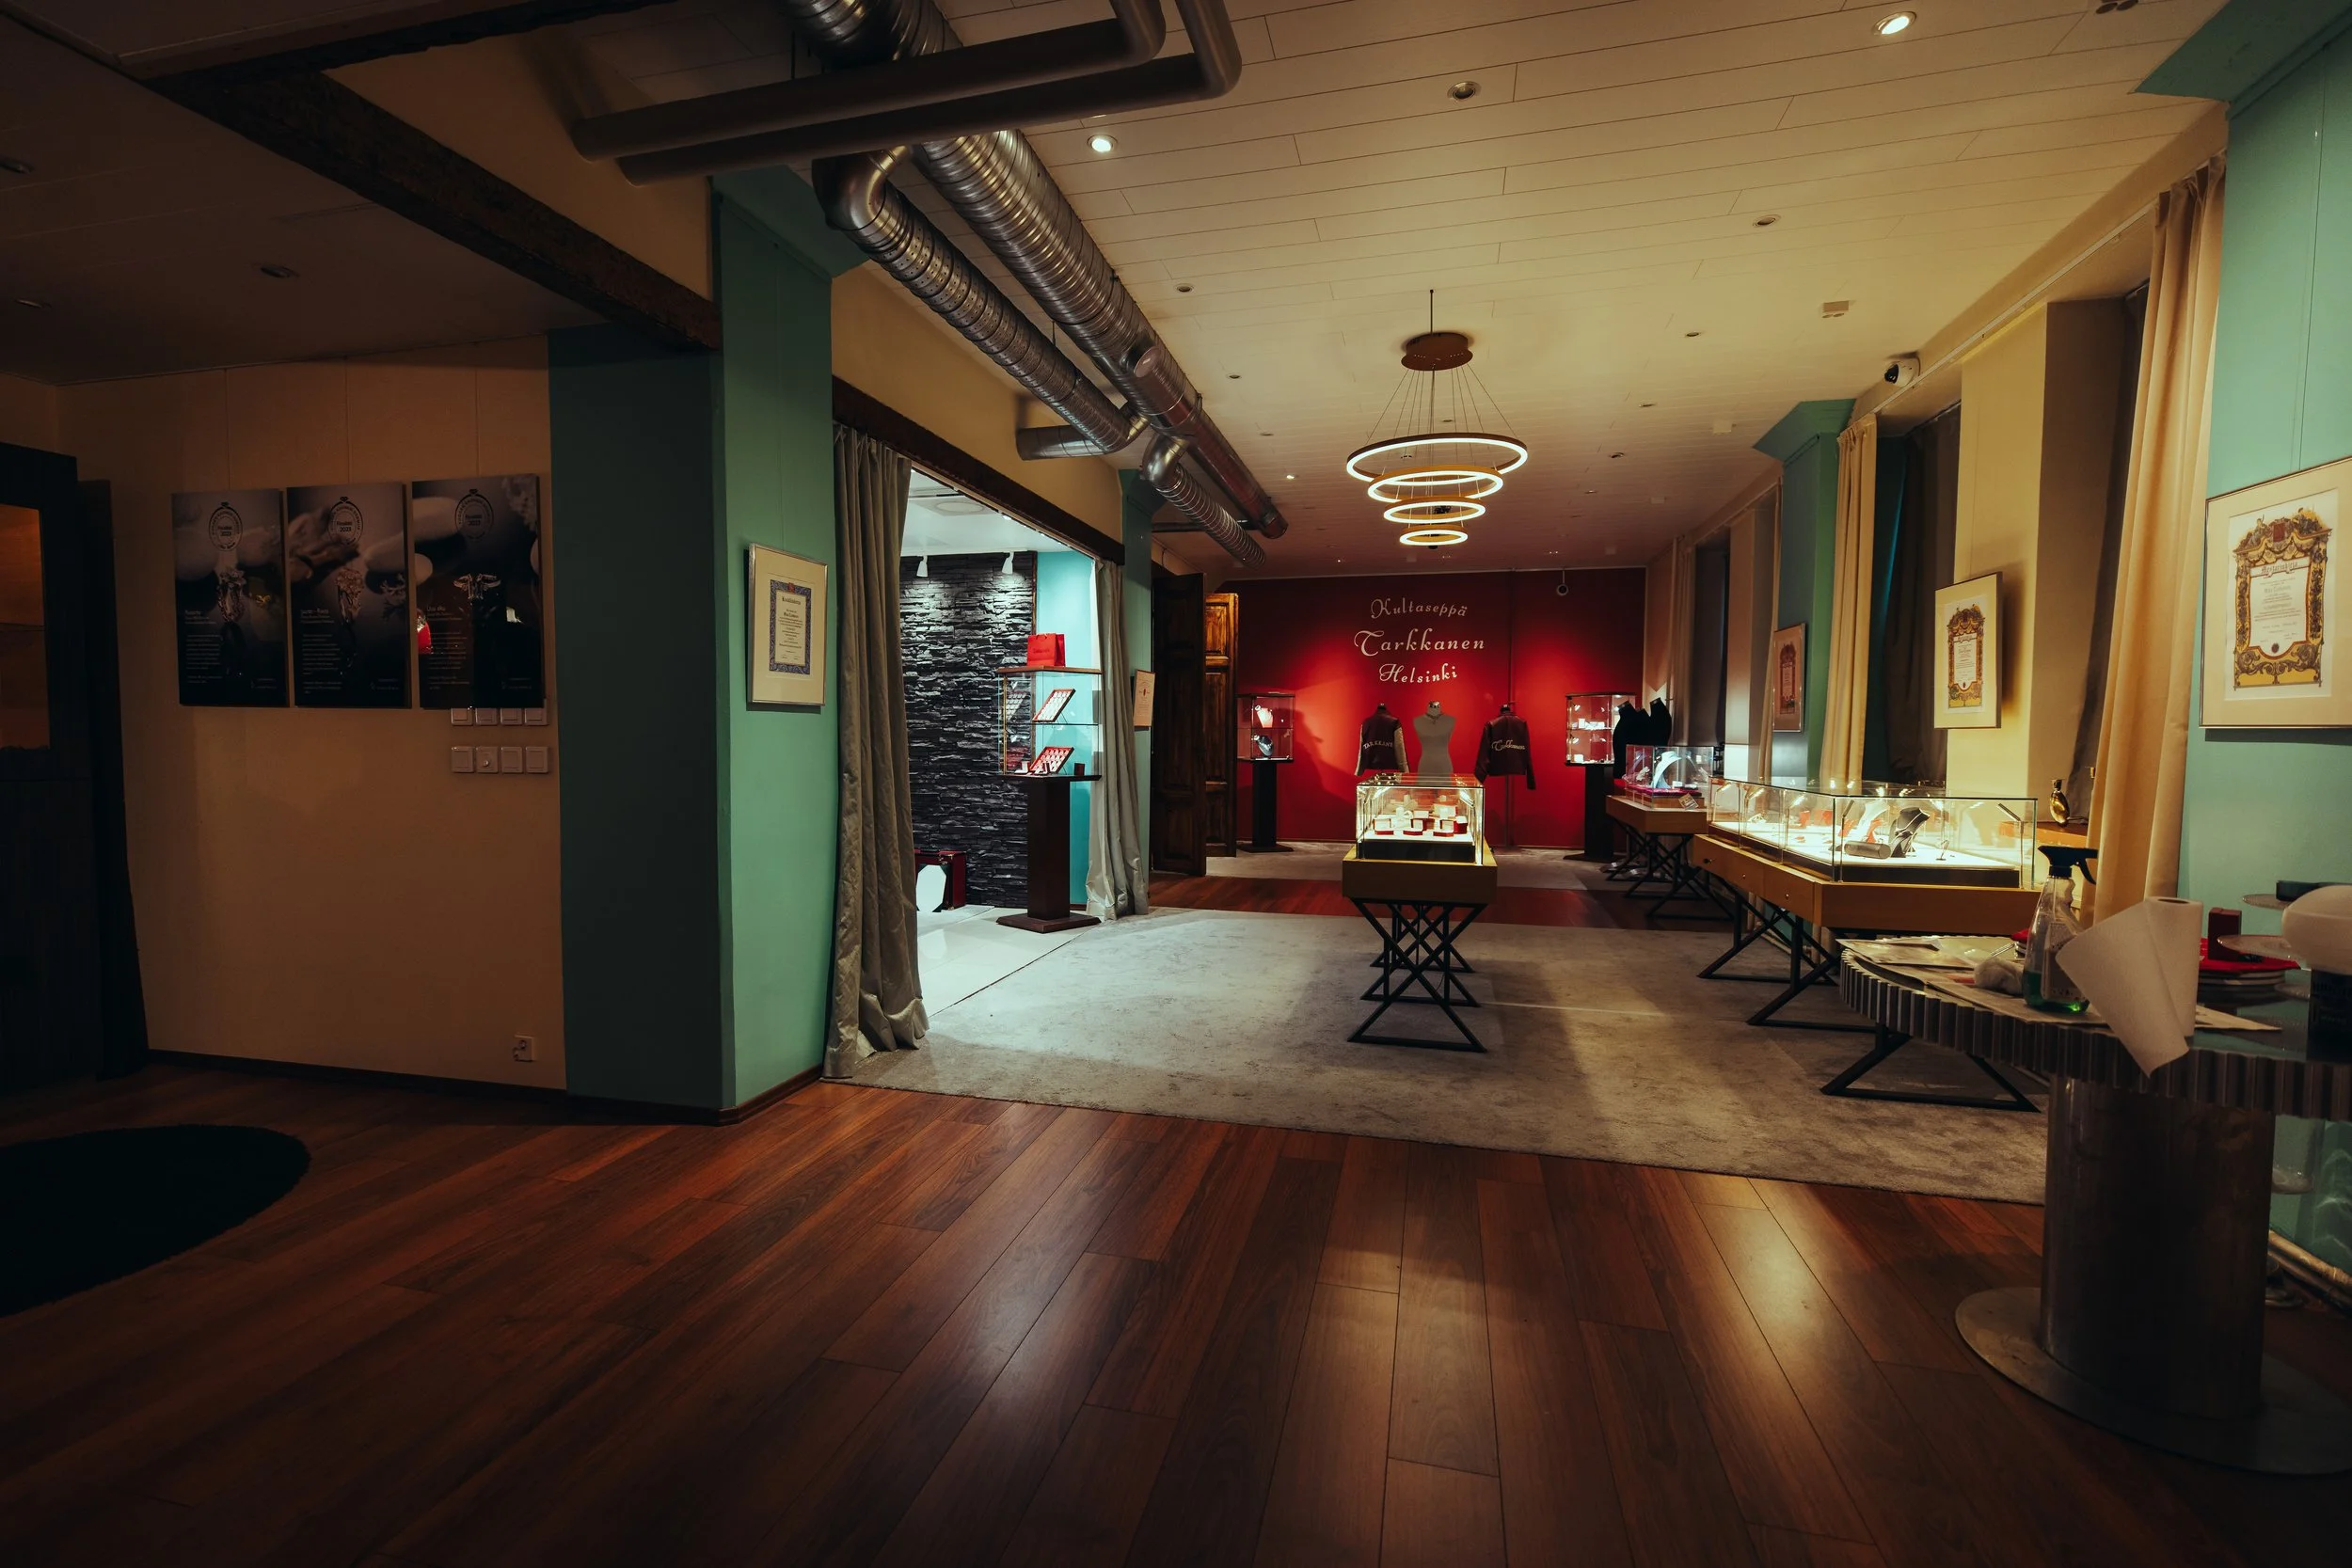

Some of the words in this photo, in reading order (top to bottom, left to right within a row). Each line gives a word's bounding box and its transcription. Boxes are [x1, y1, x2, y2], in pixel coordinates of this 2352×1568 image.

[1371, 597, 1468, 619] Kultaseppä
[1354, 627, 1485, 657] Tarkkanen
[1379, 662, 1457, 684] Helsinki
